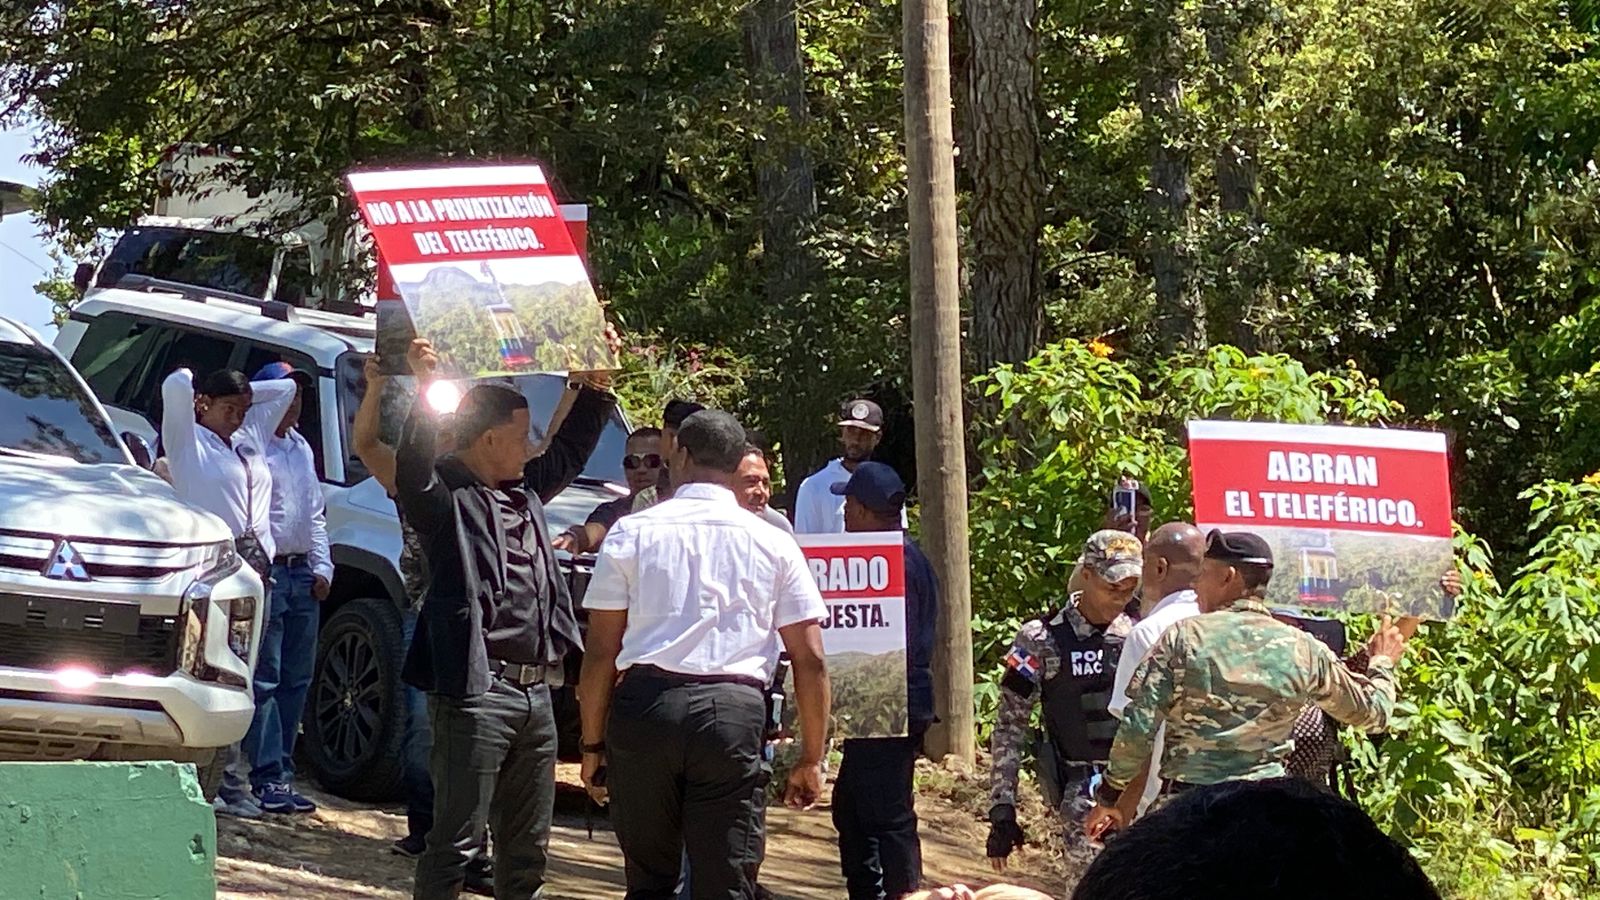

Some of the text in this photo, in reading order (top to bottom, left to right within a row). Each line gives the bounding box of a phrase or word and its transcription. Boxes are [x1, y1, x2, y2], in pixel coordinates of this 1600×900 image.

[366, 192, 555, 226] NO A LA PRIVATIZACIÓN
[413, 225, 544, 255] DEL TELEFÉRICO.
[1267, 451, 1379, 487] ABRAN
[1224, 490, 1424, 527] EL TELEFÉRICO.
[808, 555, 889, 591] RADO
